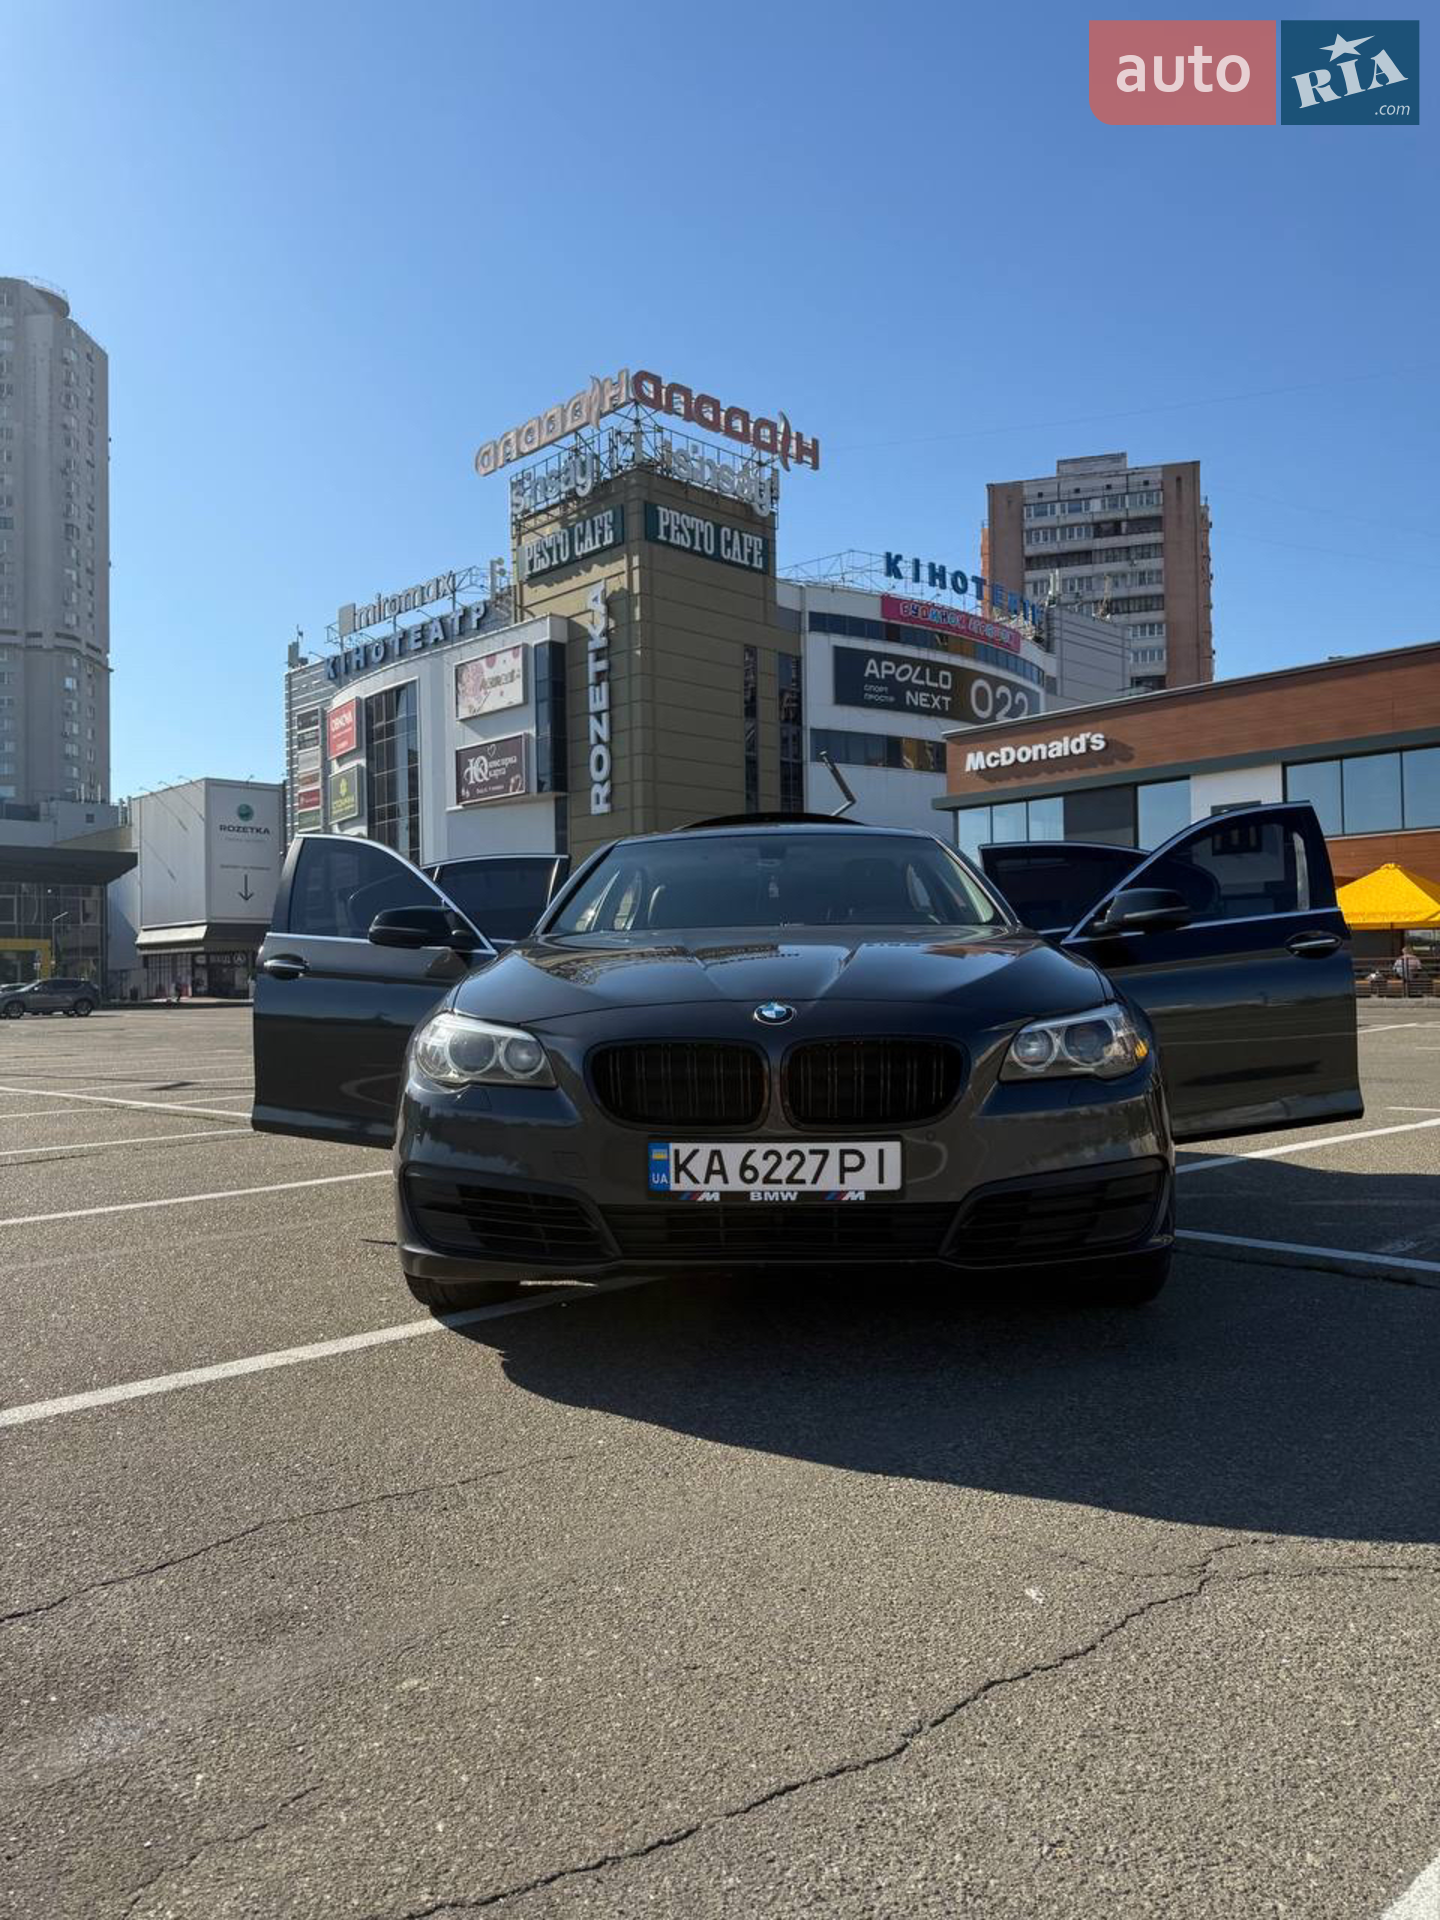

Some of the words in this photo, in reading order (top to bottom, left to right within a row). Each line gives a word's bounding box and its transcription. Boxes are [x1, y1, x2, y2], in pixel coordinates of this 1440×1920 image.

[523, 529, 570, 576] PESTO
[574, 510, 613, 555] CAFE
[657, 506, 714, 554] PESTO
[720, 526, 764, 569] CAFE
[884, 551, 1043, 626] КІНОТЕ
[325, 600, 487, 680] КІНОТЕАТР
[863, 658, 953, 691] APOLLO
[586, 580, 612, 815] ROZETKA
[905, 690, 952, 712] NEXT
[970, 679, 1030, 721] 022
[965, 732, 1107, 772] McDonald's
[219, 824, 271, 835] ROZETKA
[652, 1174, 669, 1184] UA
[673, 1148, 729, 1184] KA
[739, 1149, 829, 1184] 6227
[838, 1148, 885, 1184] PI
[749, 1191, 798, 1201] BMW
